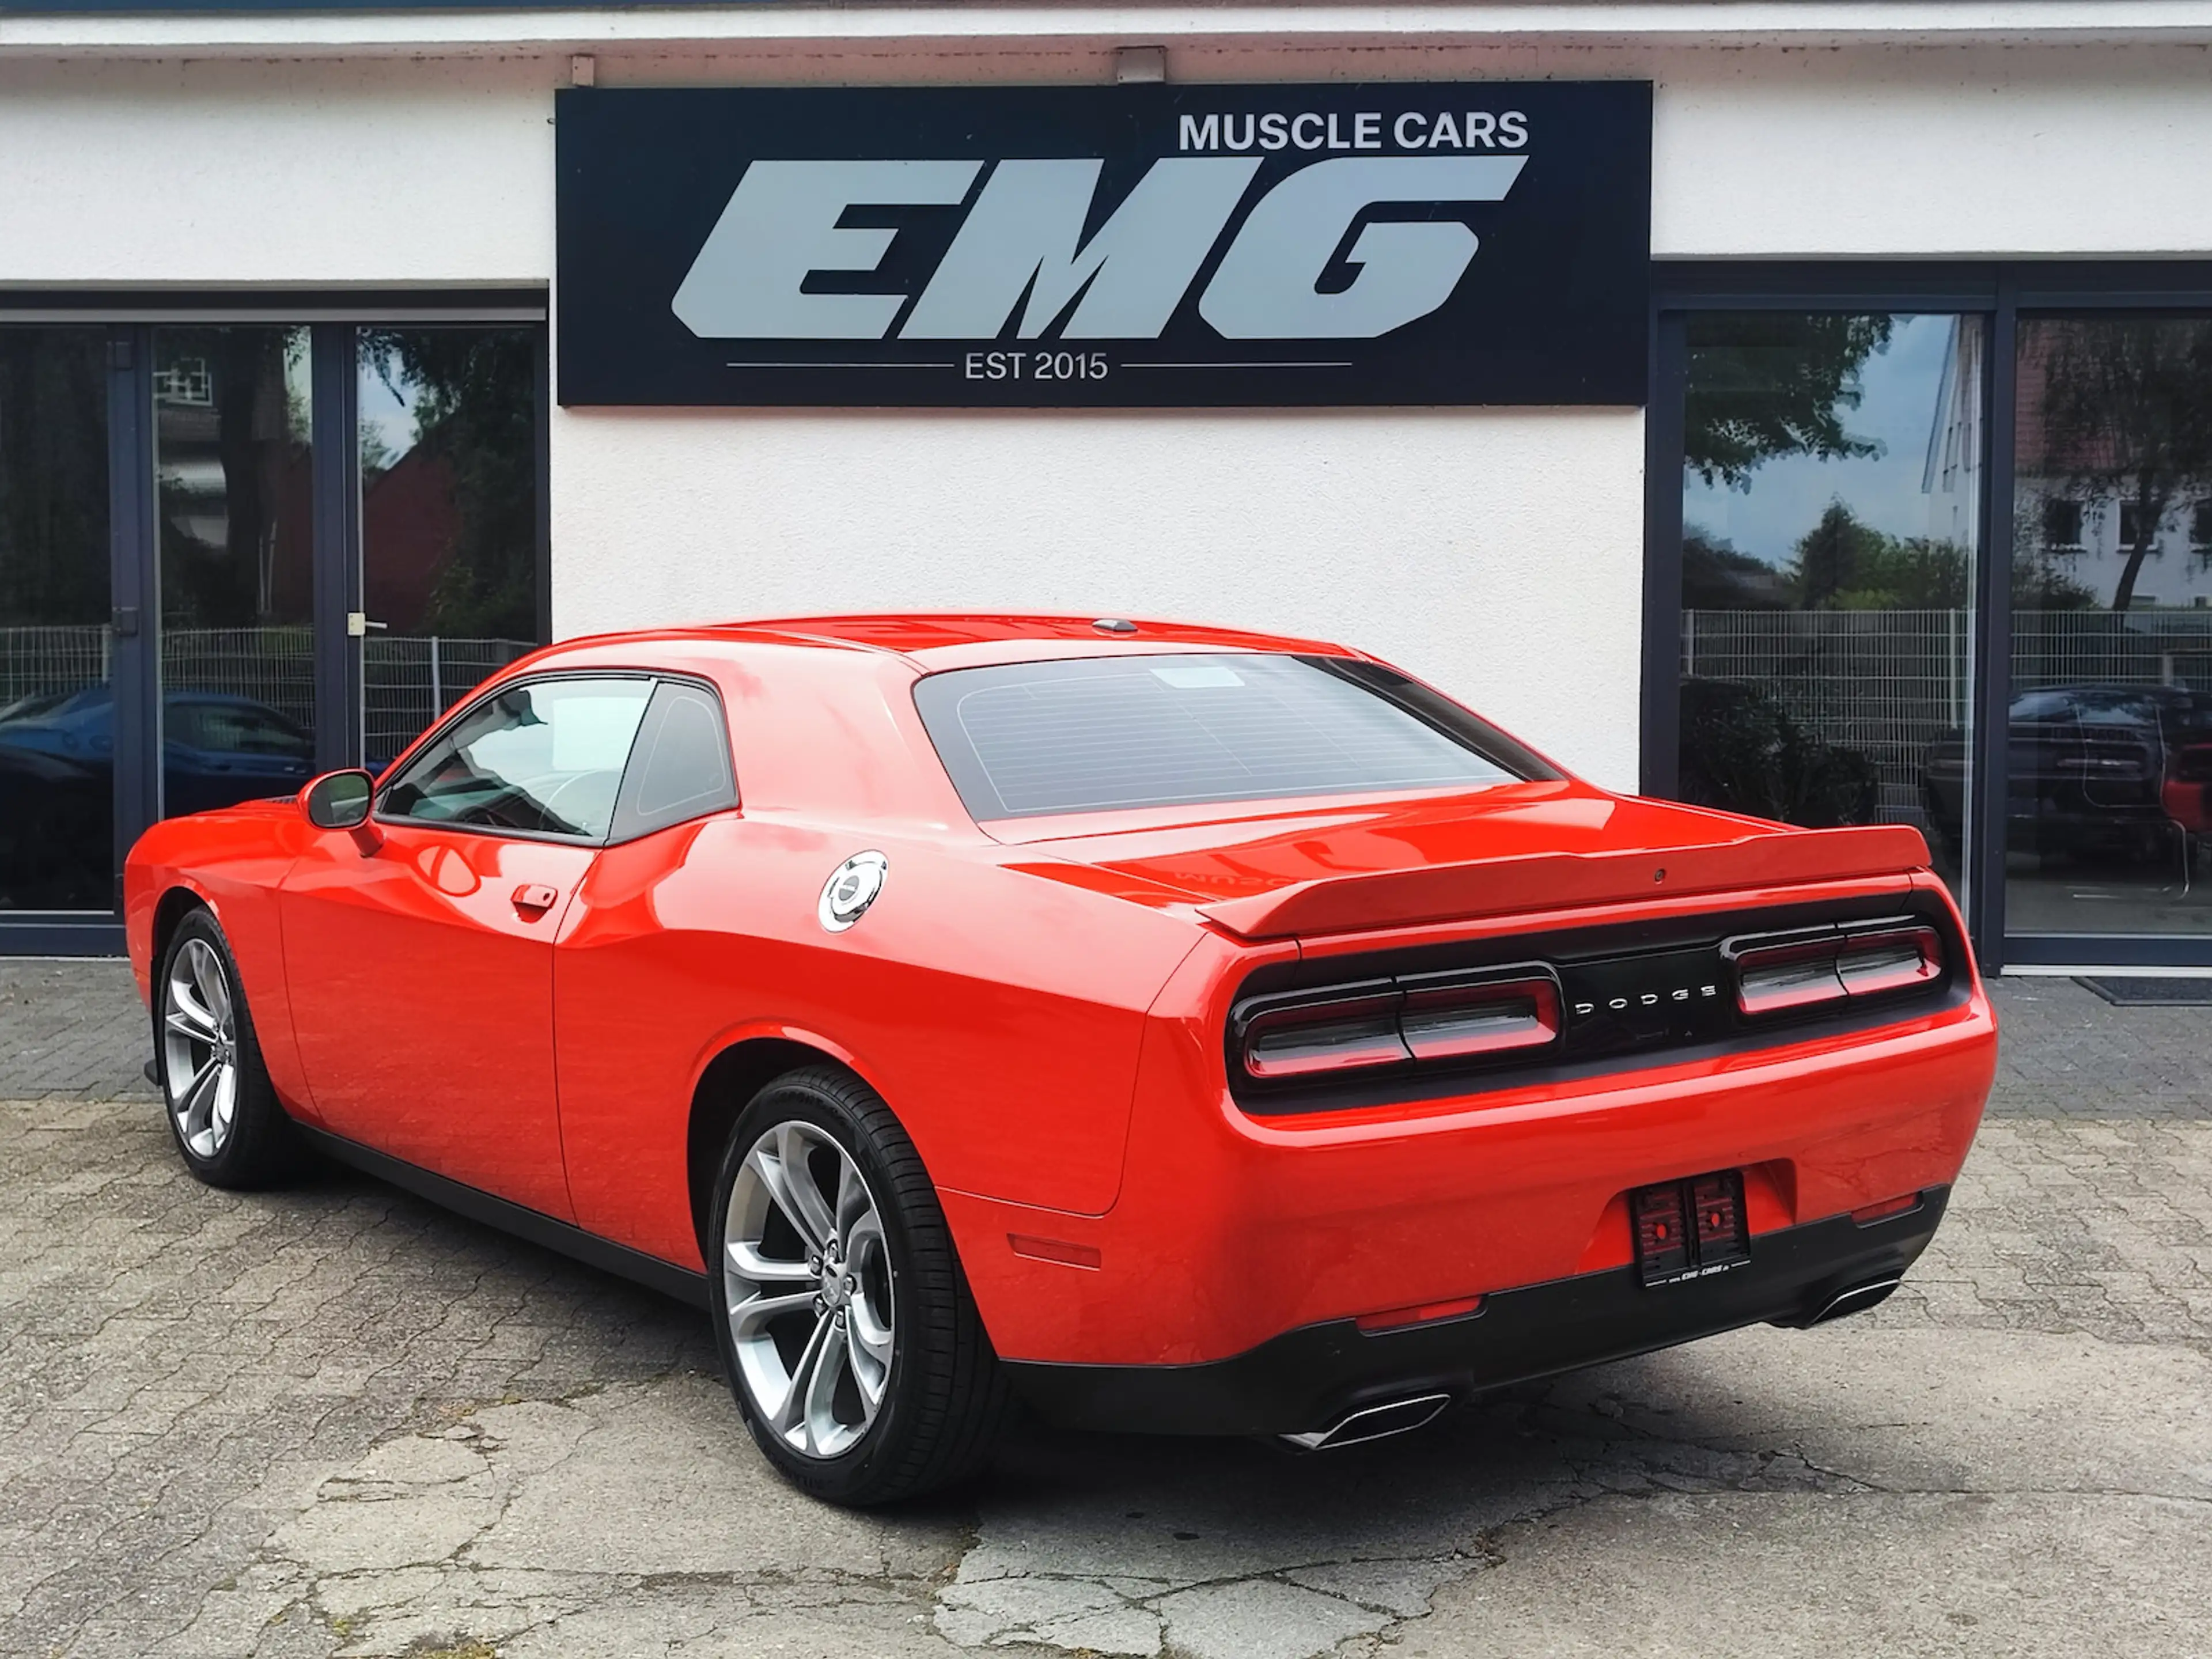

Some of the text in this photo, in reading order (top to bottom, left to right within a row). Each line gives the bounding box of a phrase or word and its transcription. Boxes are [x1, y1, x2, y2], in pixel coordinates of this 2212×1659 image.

[1180, 111, 1528, 150] MUSCLE CARS
[671, 155, 1529, 339] EMG
[966, 352, 1108, 379] EST 2015
[1575, 985, 1717, 1014] DODGE
